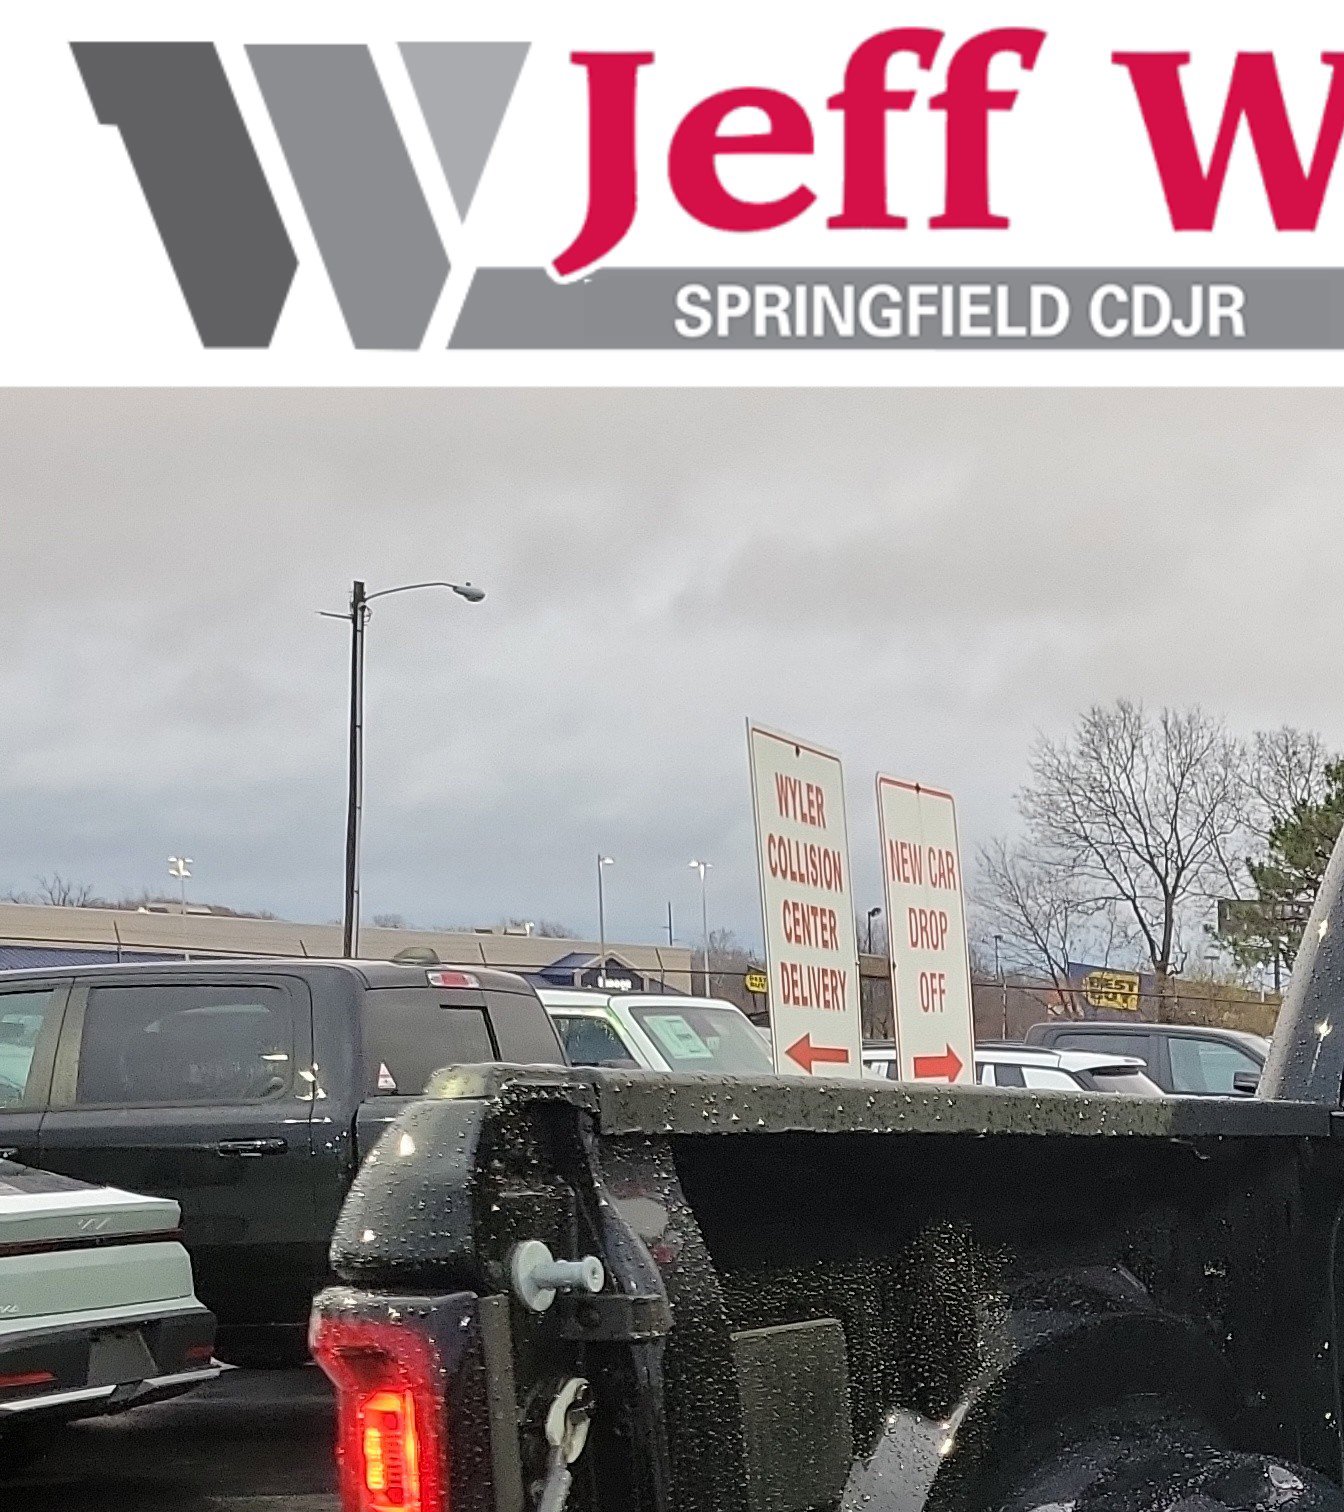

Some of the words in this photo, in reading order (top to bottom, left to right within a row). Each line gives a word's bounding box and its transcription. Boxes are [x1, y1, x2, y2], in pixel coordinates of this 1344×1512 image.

[774, 772, 827, 829] WYLER
[767, 833, 844, 893] COLLISION
[889, 839, 922, 885] NEW
[928, 847, 957, 890] CAR
[782, 899, 839, 950] CENTER
[908, 907, 948, 951] DROP
[780, 961, 847, 1012] DELIVERY
[919, 971, 946, 1013] OFF
